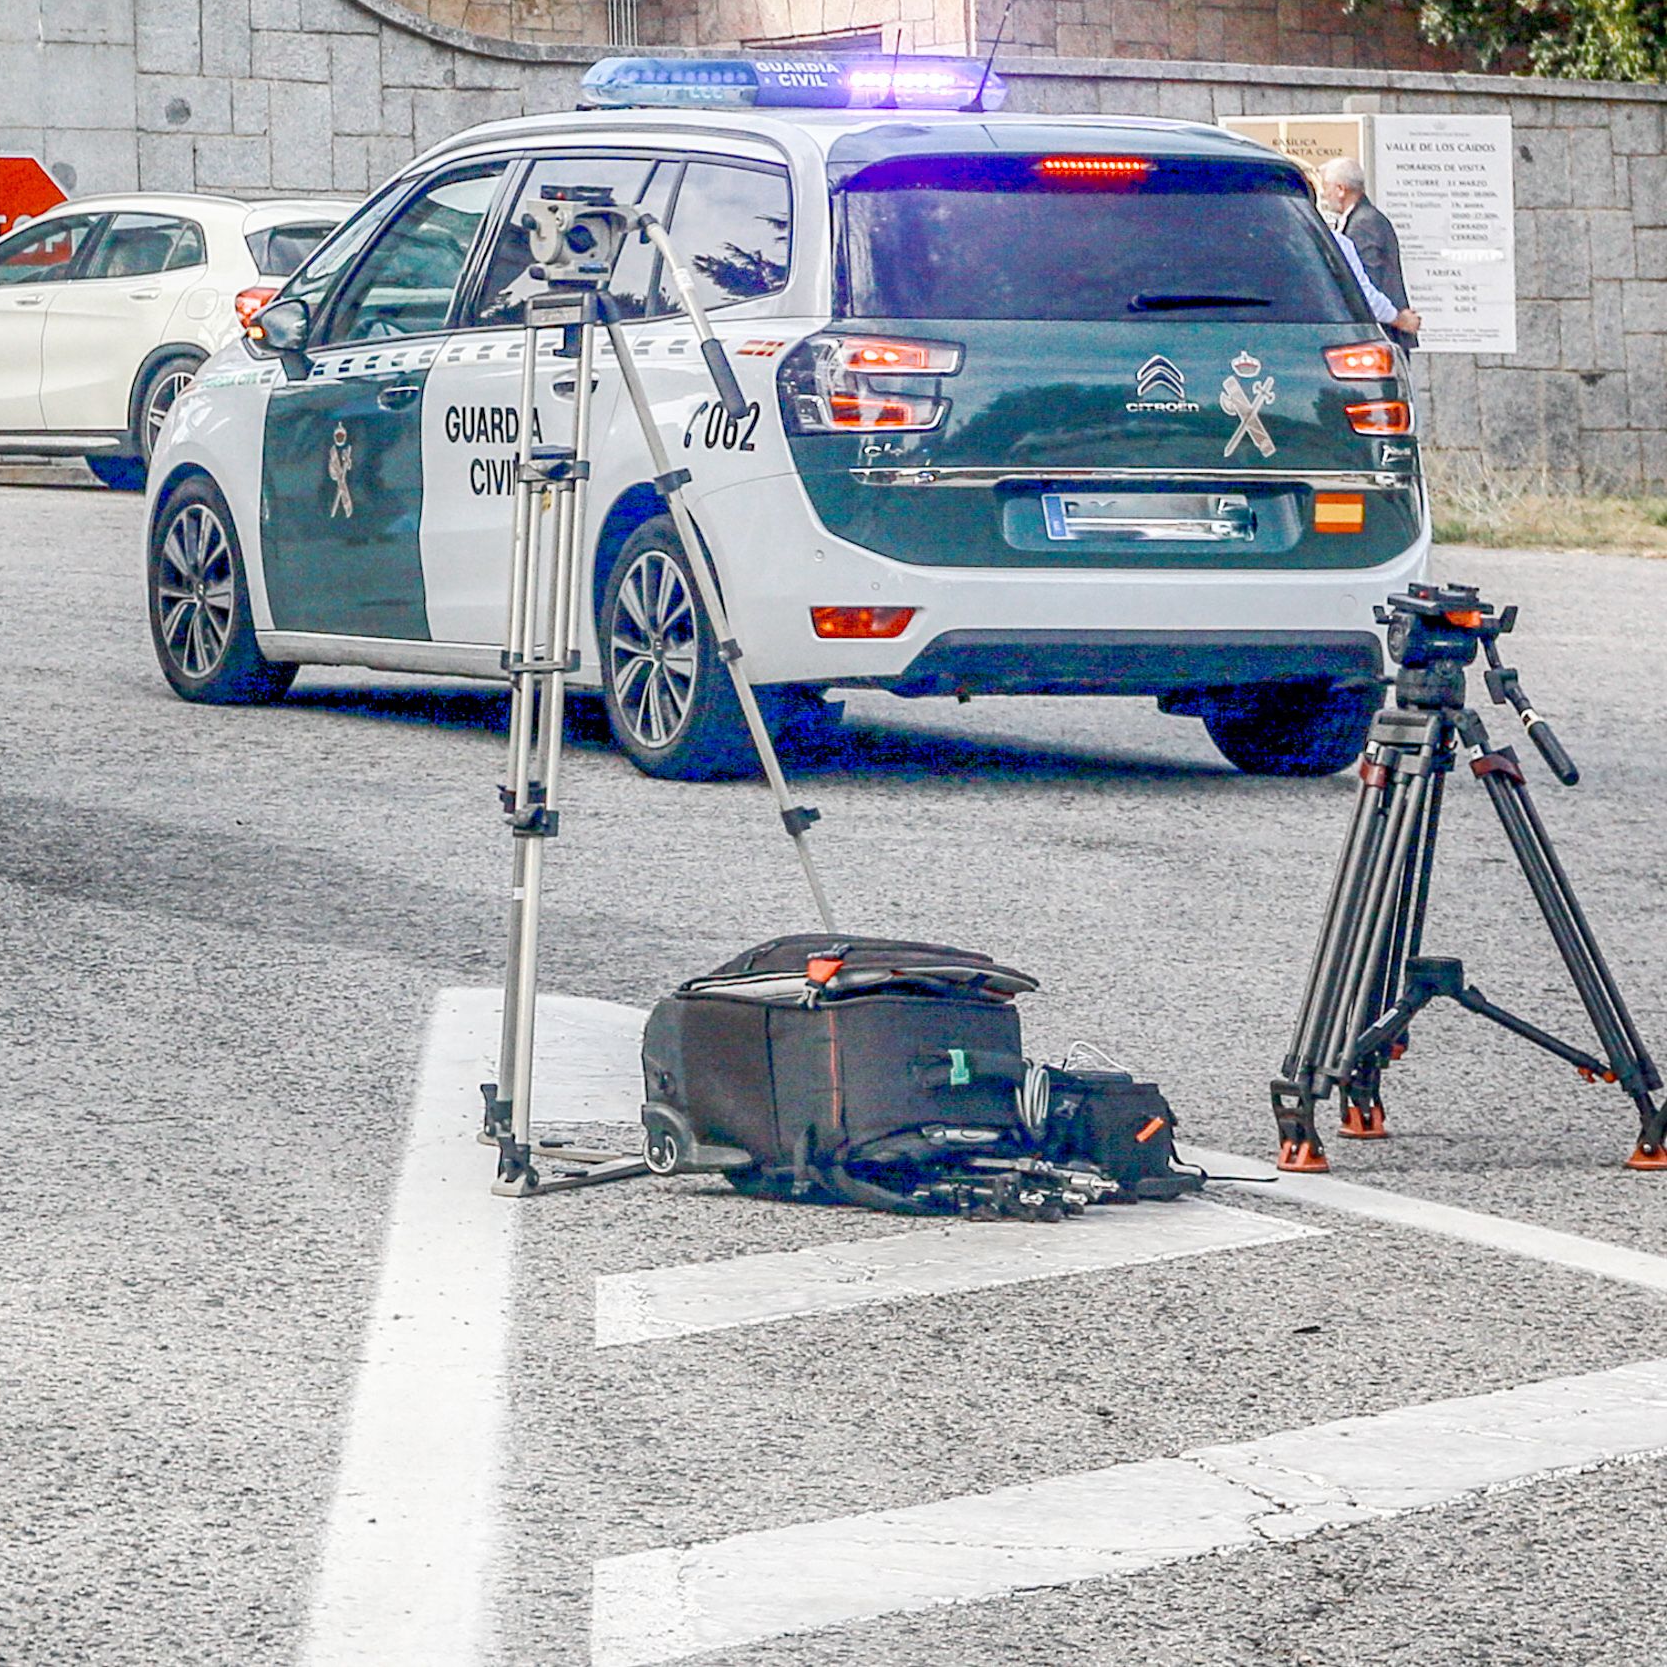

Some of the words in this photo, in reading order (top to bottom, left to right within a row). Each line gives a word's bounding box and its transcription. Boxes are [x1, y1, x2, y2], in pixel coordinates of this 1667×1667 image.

[755, 61, 840, 74] GUARDIA
[778, 73, 829, 87] CIVIL
[1317, 147, 1344, 156] CRUZ
[1385, 142, 1416, 153] VALLE
[1419, 142, 1433, 153] DE
[1435, 142, 1455, 153] LOS
[1395, 163, 1442, 172] HORARIOS
[704, 401, 761, 451] 062
